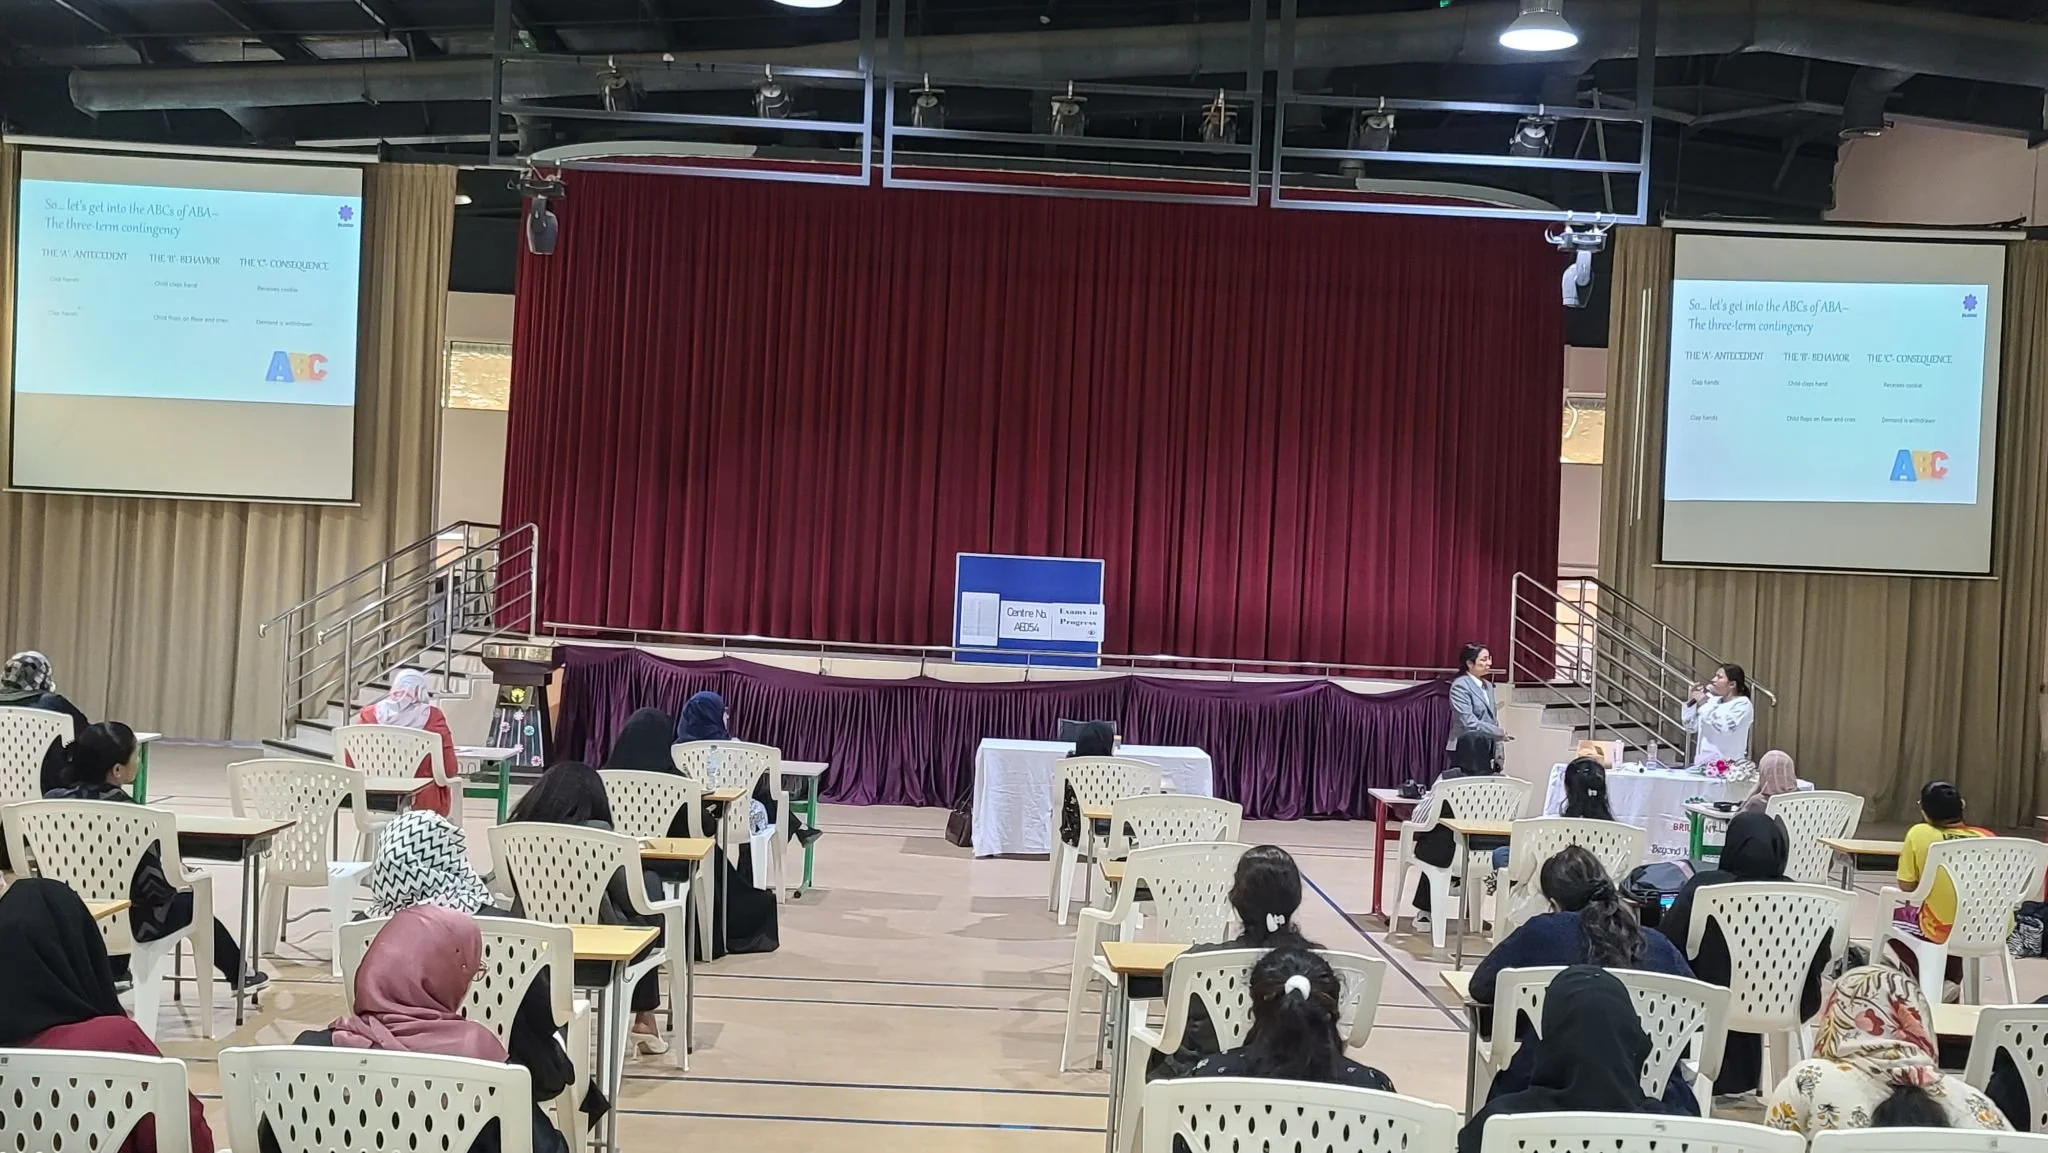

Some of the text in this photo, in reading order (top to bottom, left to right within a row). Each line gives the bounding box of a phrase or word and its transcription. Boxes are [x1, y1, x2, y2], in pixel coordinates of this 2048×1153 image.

[67, 197, 87, 212] let's
[88, 201, 104, 216] get
[107, 201, 126, 214] into
[129, 201, 145, 215] the
[147, 203, 174, 216] ABCs
[177, 204, 189, 220] of
[45, 217, 181, 239] The three-term contingency
[41, 248, 60, 257] THE
[74, 250, 128, 261] ANTECEDENT
[149, 253, 165, 263] THE
[179, 255, 221, 265] BEHAVIOR
[240, 258, 255, 267] THE
[270, 259, 330, 273] CONSEQUENCE
[1709, 297, 1727, 311] let's
[1728, 300, 1743, 315] get
[1745, 300, 1763, 312] into
[1766, 300, 1780, 312] the
[1782, 300, 1808, 313] ABCs
[1809, 299, 1821, 317] of
[1688, 317, 1814, 336] The three-term contingency
[1685, 351, 1700, 360] THE
[1714, 351, 1764, 361] ANTECEDENT
[1784, 352, 1799, 361] THE
[1812, 352, 1850, 362] BEHAVIOR
[1867, 354, 1882, 363] THE
[1896, 354, 1952, 366] CONSEQUENCE
[265, 350, 329, 383] ABC
[1889, 449, 1949, 482] ABC
[1007, 607, 1034, 617] Centre
[1060, 618, 1096, 626] Progress
[1651, 844, 1681, 856] Beyond
